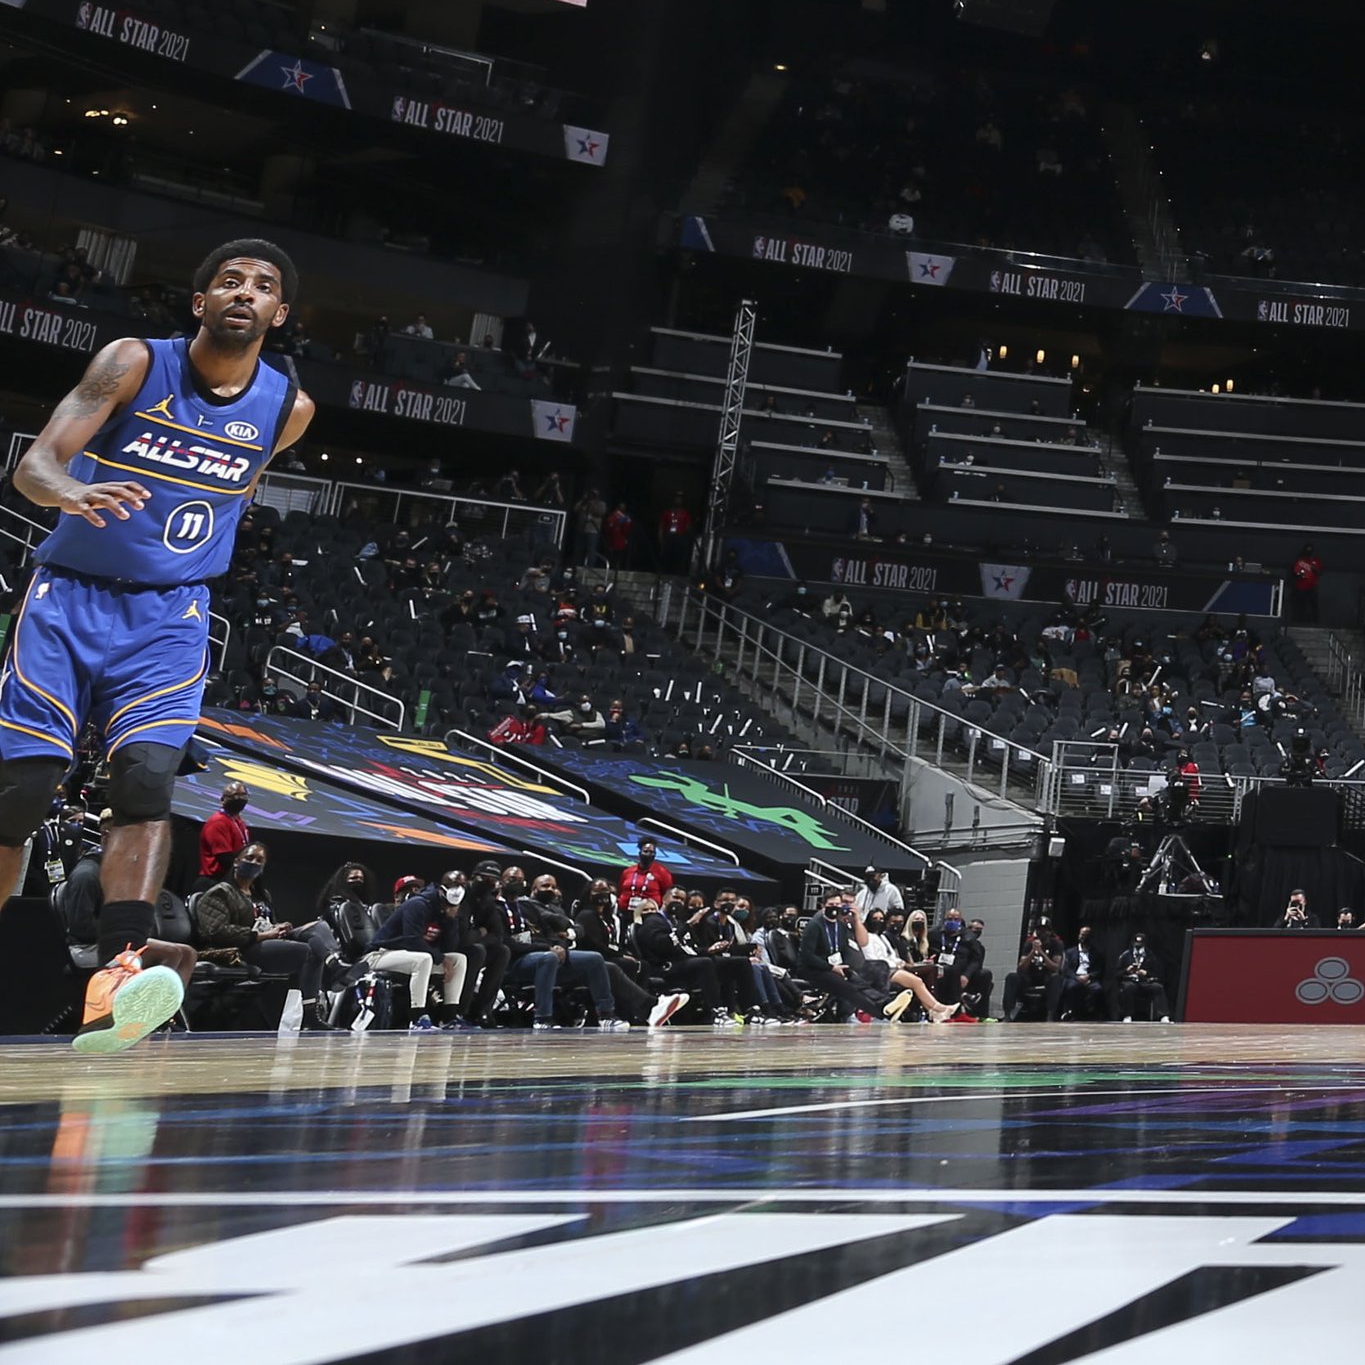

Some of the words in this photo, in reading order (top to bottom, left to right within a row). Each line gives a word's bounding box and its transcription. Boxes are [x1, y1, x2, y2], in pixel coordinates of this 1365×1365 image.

[89, 6, 116, 38] ALL
[120, 16, 159, 52] STAR
[158, 30, 191, 62] 2021
[405, 100, 429, 128] ALL
[435, 106, 473, 137] STAR
[473, 115, 504, 143] 2021
[765, 238, 787, 261] ALL
[792, 242, 824, 268] STAR
[825, 249, 853, 273] 2021
[1001, 273, 1022, 295] ALL
[1027, 276, 1058, 299] STAR
[1060, 281, 1086, 302] 2021
[1269, 301, 1289, 322] ALL
[1294, 303, 1325, 325] STAR
[1325, 305, 1349, 327] 2021
[20, 308, 62, 345] STAR
[62, 319, 97, 352] 2021
[363, 381, 389, 412] ALL
[395, 386, 433, 420] STAR
[433, 393, 466, 425] 2021
[230, 424, 252, 438] KIA
[176, 512, 205, 540] 11
[844, 560, 867, 583] ALL
[873, 561, 907, 588] STAR
[908, 566, 937, 591] 2021
[1105, 583, 1139, 607] STAR
[1140, 586, 1168, 609] 2021
